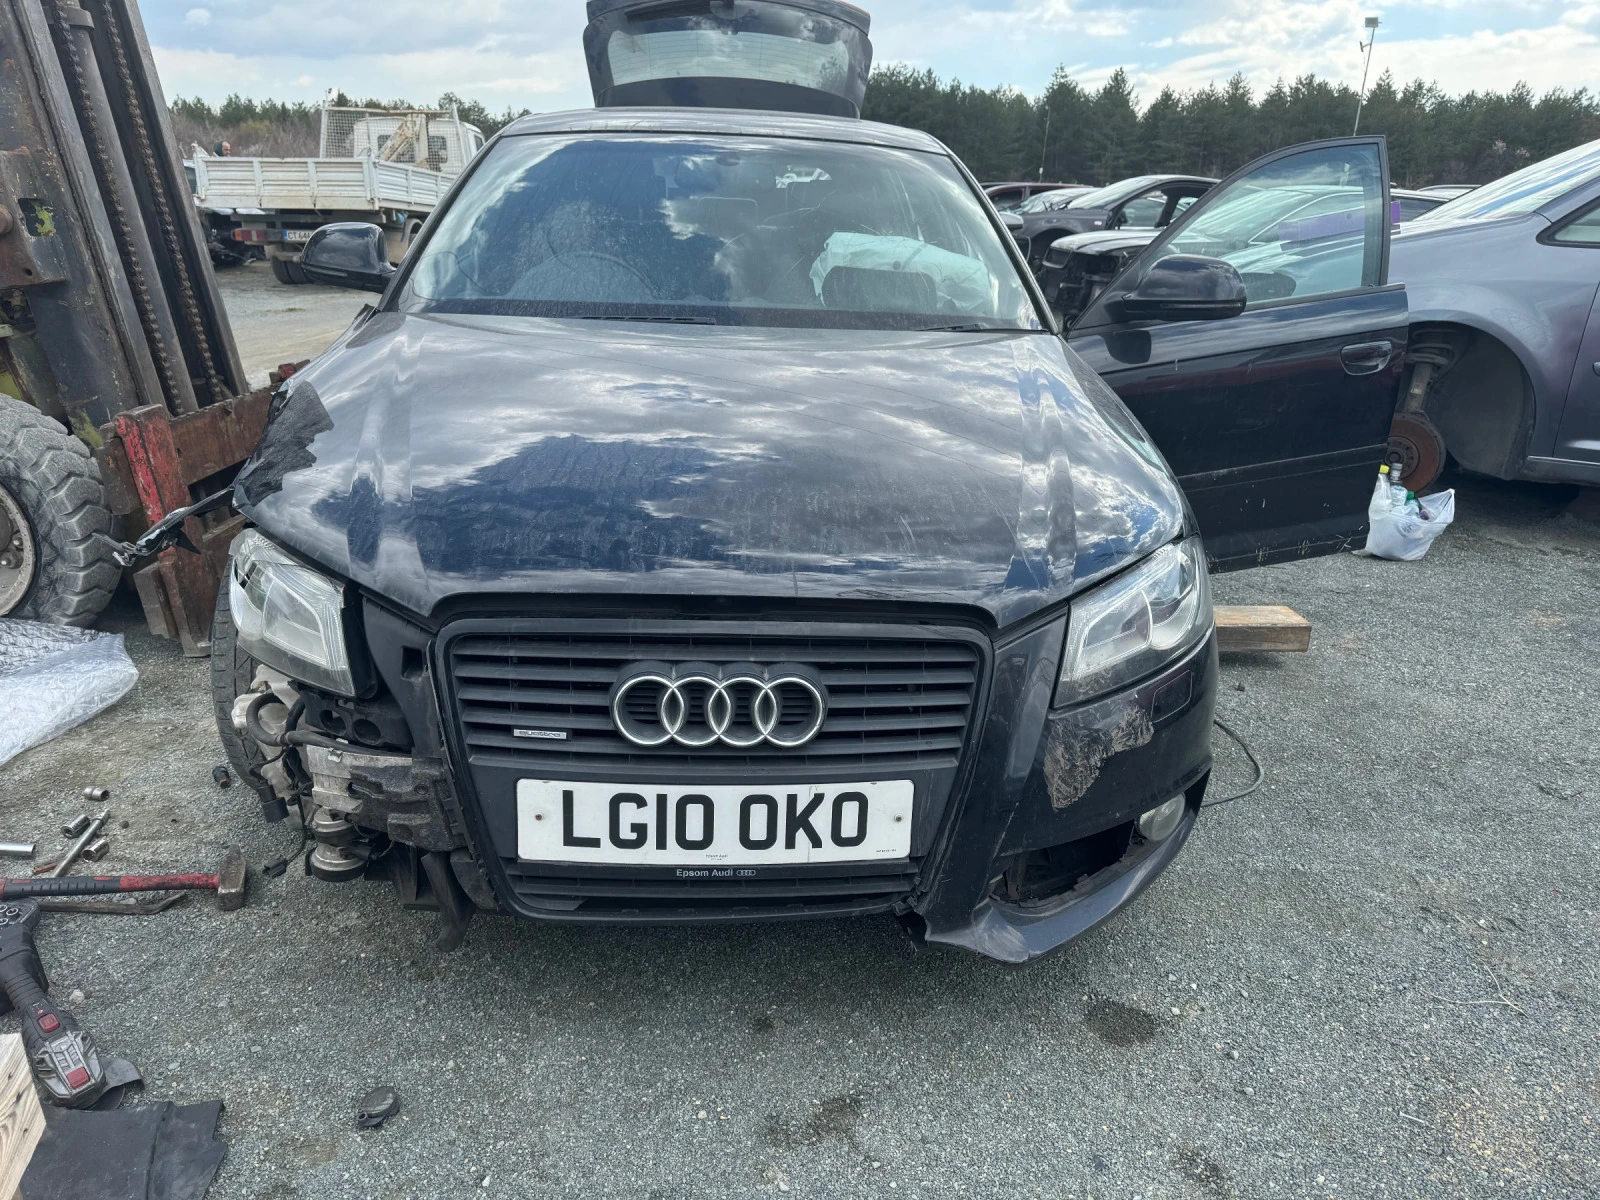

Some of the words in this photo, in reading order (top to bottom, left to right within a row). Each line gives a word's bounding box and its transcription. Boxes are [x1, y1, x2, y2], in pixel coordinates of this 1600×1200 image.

[518, 730, 561, 738] quattro
[562, 789, 715, 851] LG10
[738, 791, 869, 851] OKO
[676, 869, 709, 878] Epsom
[711, 868, 733, 877] Audi
